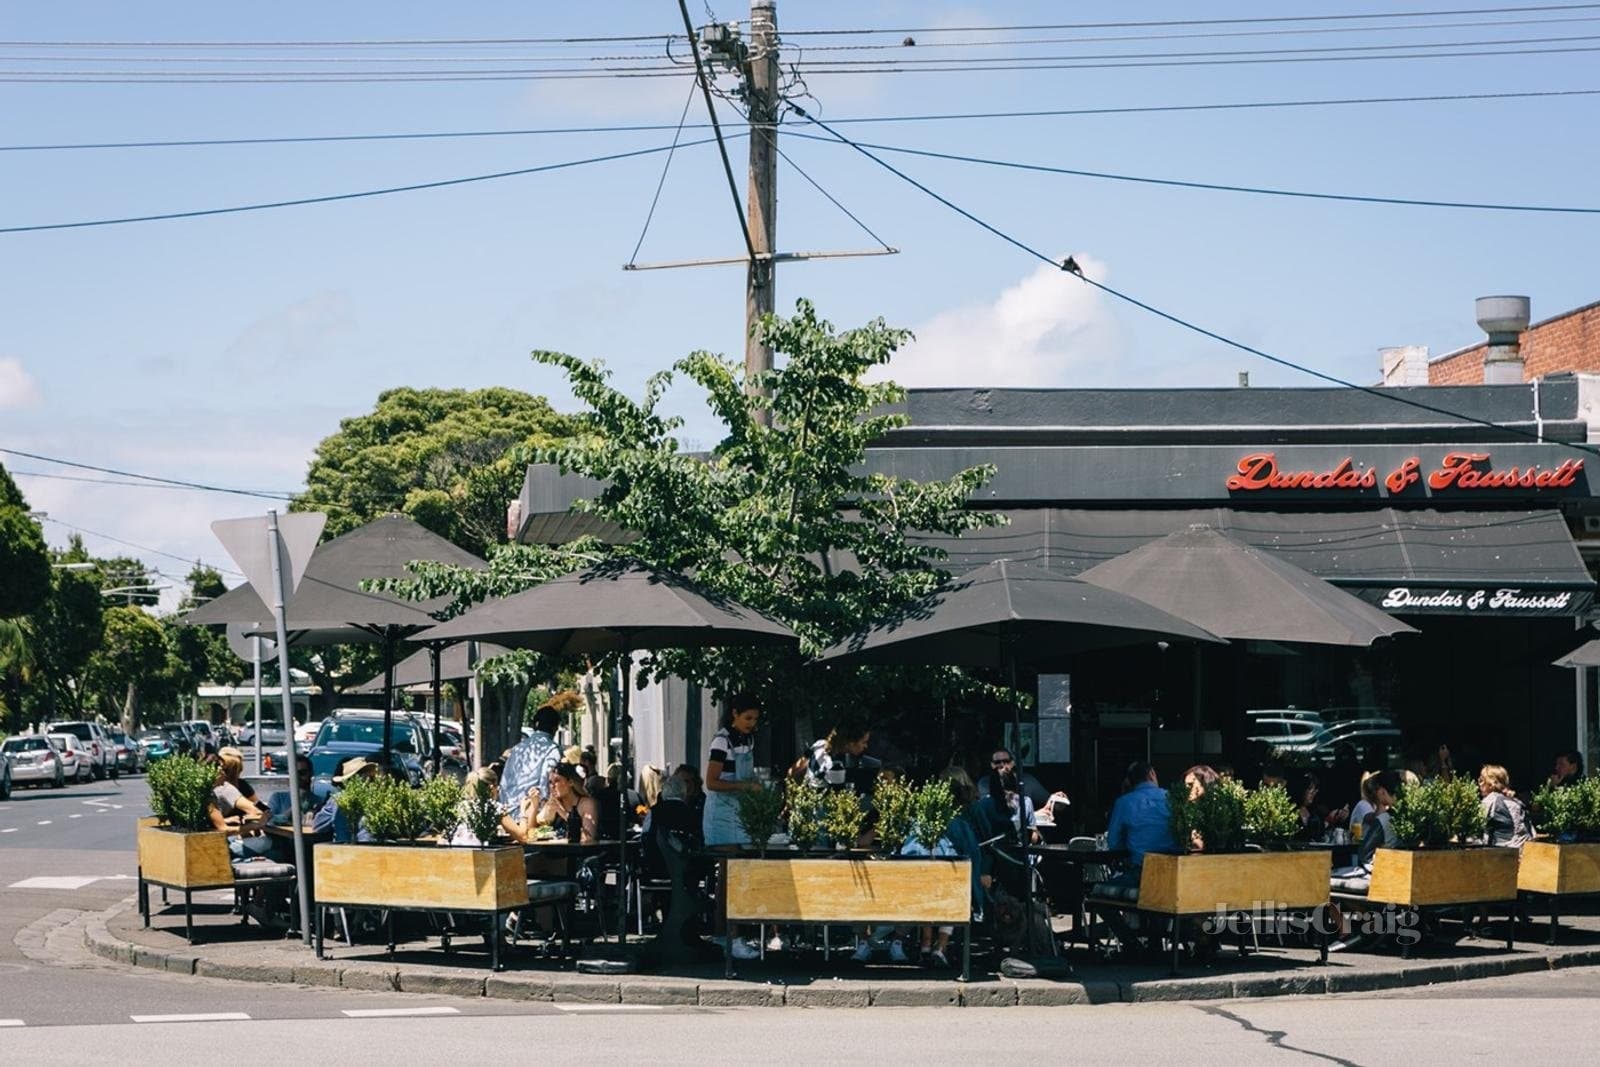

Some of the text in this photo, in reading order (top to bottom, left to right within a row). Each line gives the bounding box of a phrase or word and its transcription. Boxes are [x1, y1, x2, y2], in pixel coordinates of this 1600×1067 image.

[1225, 452, 1585, 494] Dundas & Faussett
[1382, 588, 1570, 609] Dundas & Faussett
